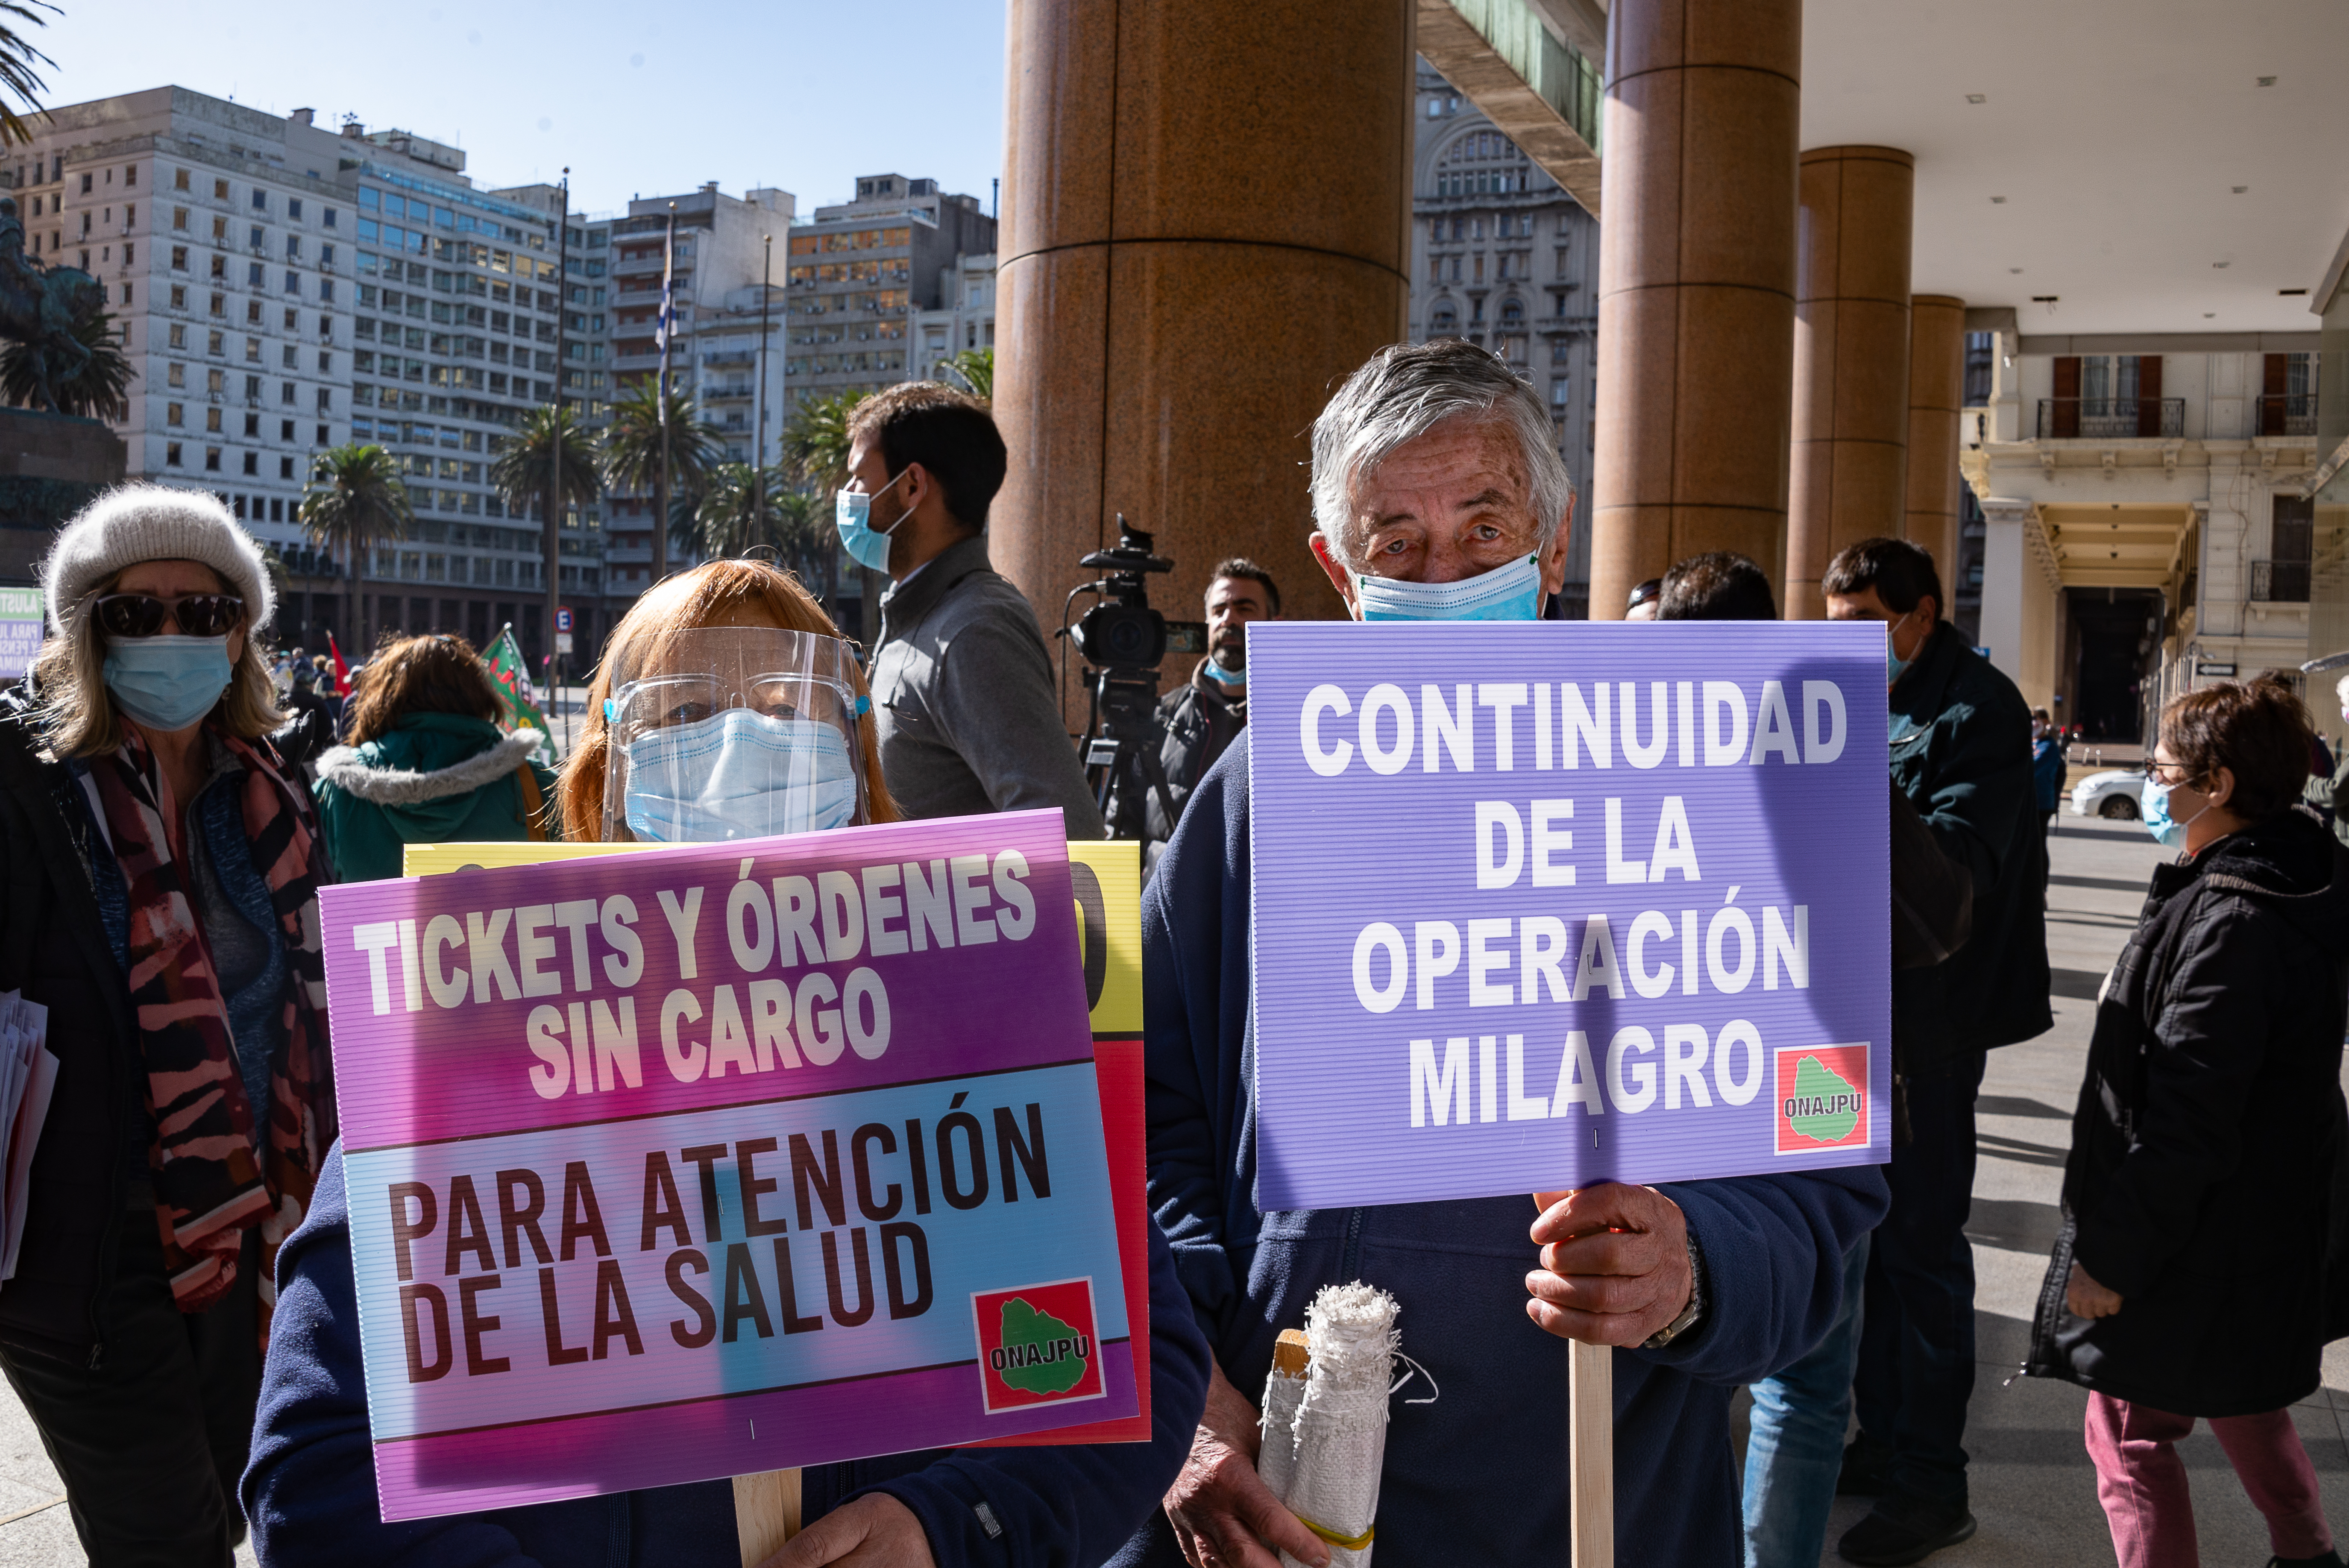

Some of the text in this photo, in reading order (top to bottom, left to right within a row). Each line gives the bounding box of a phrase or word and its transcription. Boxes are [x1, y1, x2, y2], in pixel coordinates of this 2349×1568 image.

[558, 611, 568, 630] E
[1300, 680, 1846, 777] CONTINUIDAD
[1475, 796, 1702, 890] DE LA
[352, 895, 644, 1016] TICKETS
[656, 886, 704, 980] Y
[726, 848, 1036, 973] ÓRDENES
[1352, 885, 1809, 1014] OPERACIÓN
[526, 967, 892, 1100] SIN CARGO
[1409, 1019, 1764, 1128] MILAGRO
[1784, 1093, 1862, 1118] ONAJPU
[388, 1091, 1052, 1281] PARA ATENCIÓN
[399, 1221, 934, 1383] DE LA SALUD
[990, 1335, 1090, 1371] ONAJPU
